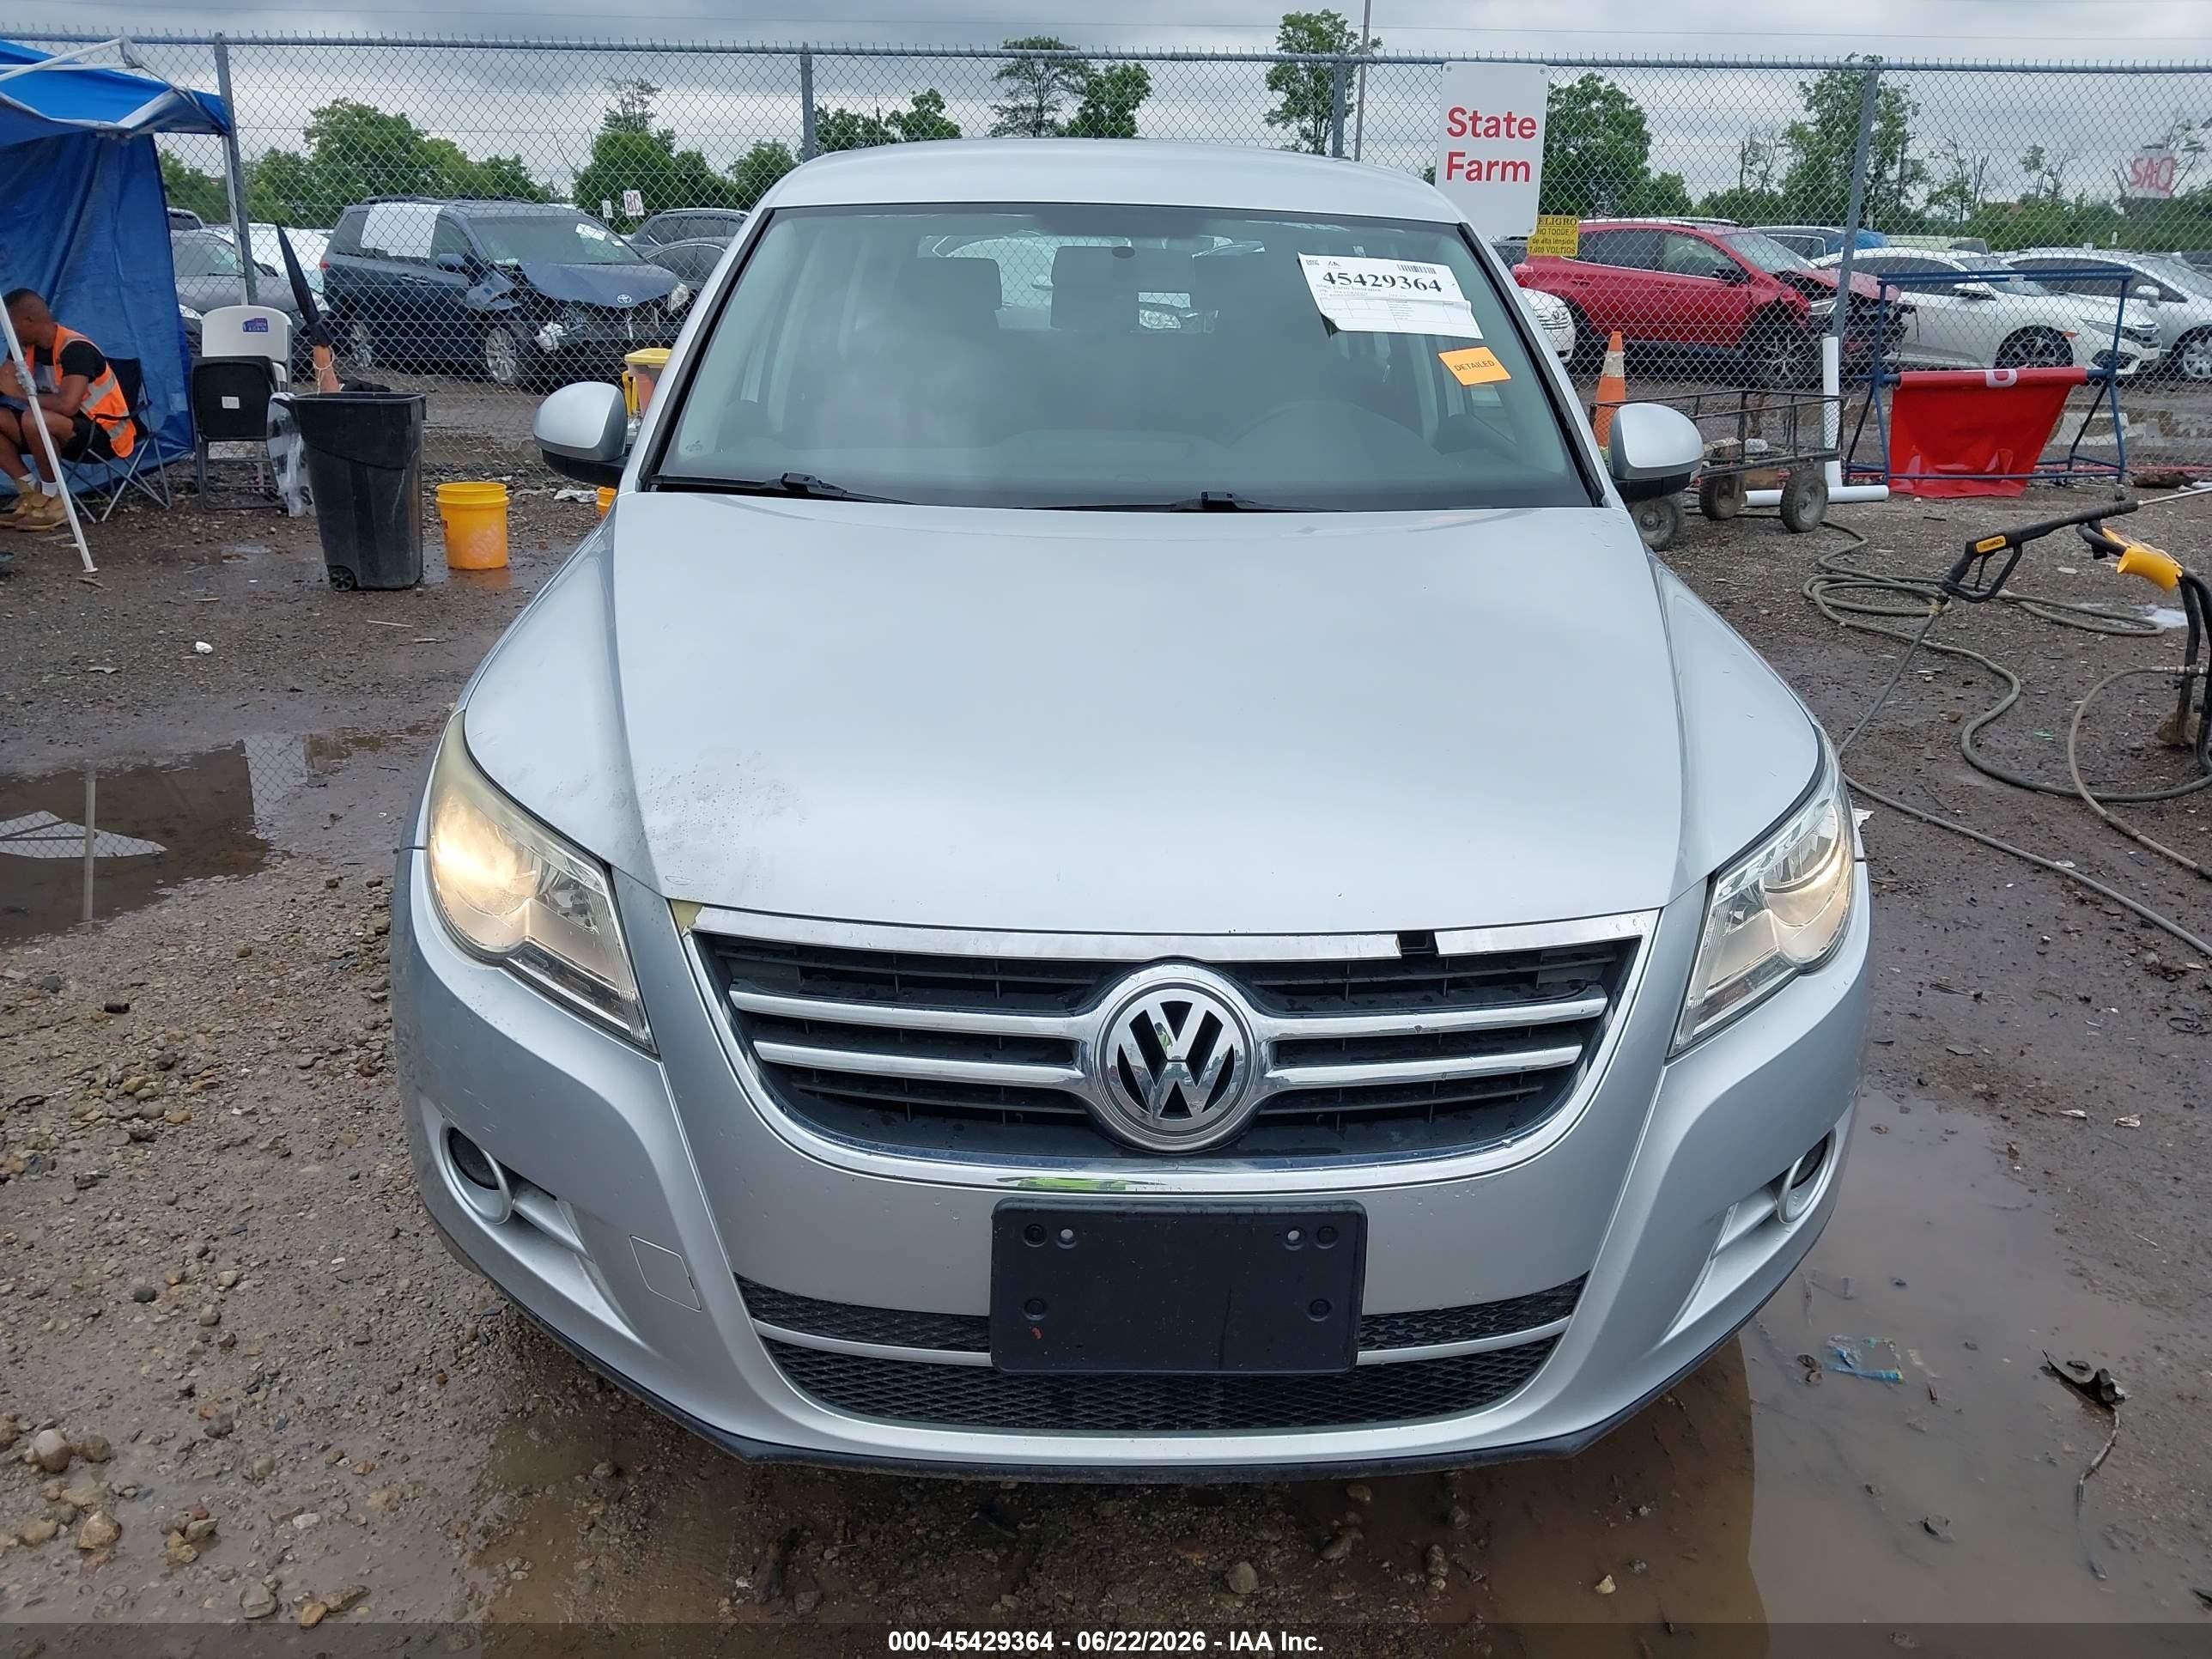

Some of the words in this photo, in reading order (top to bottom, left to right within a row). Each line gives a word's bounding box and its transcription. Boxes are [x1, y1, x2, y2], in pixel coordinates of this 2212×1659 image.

[1447, 106, 1537, 140] State
[1446, 151, 1531, 183] Farm
[1322, 272, 1442, 293] 45429364
[1454, 360, 1495, 372] DETAILED
